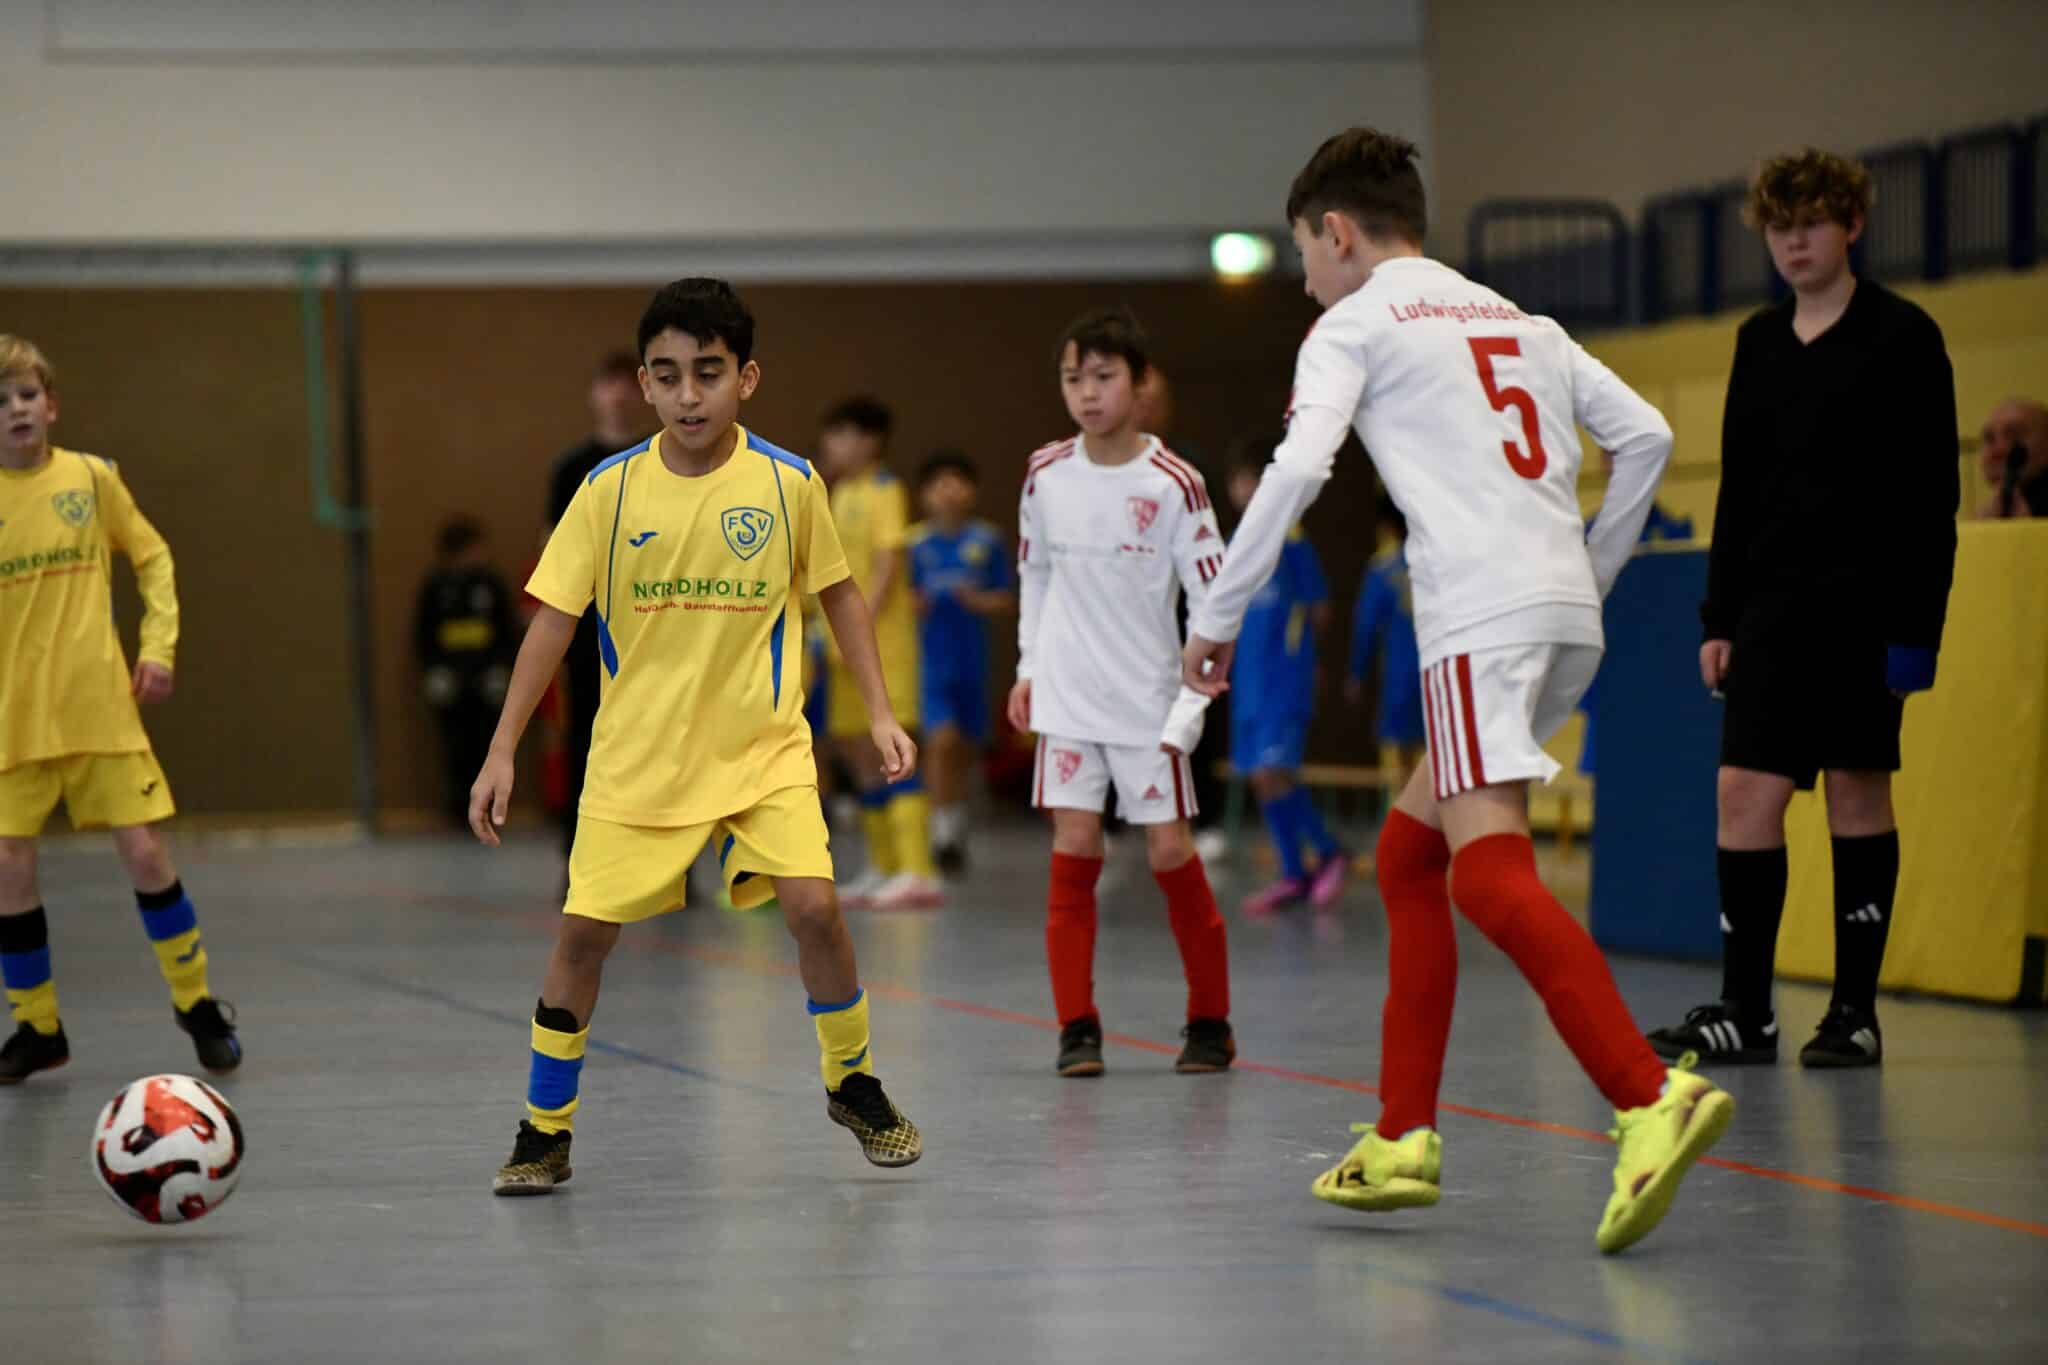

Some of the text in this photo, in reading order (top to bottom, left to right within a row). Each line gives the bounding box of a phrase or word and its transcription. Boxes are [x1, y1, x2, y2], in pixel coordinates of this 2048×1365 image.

[1467, 336, 1547, 480] 5
[728, 512, 768, 545] FSV
[633, 578, 767, 599] NORDHOLZ
